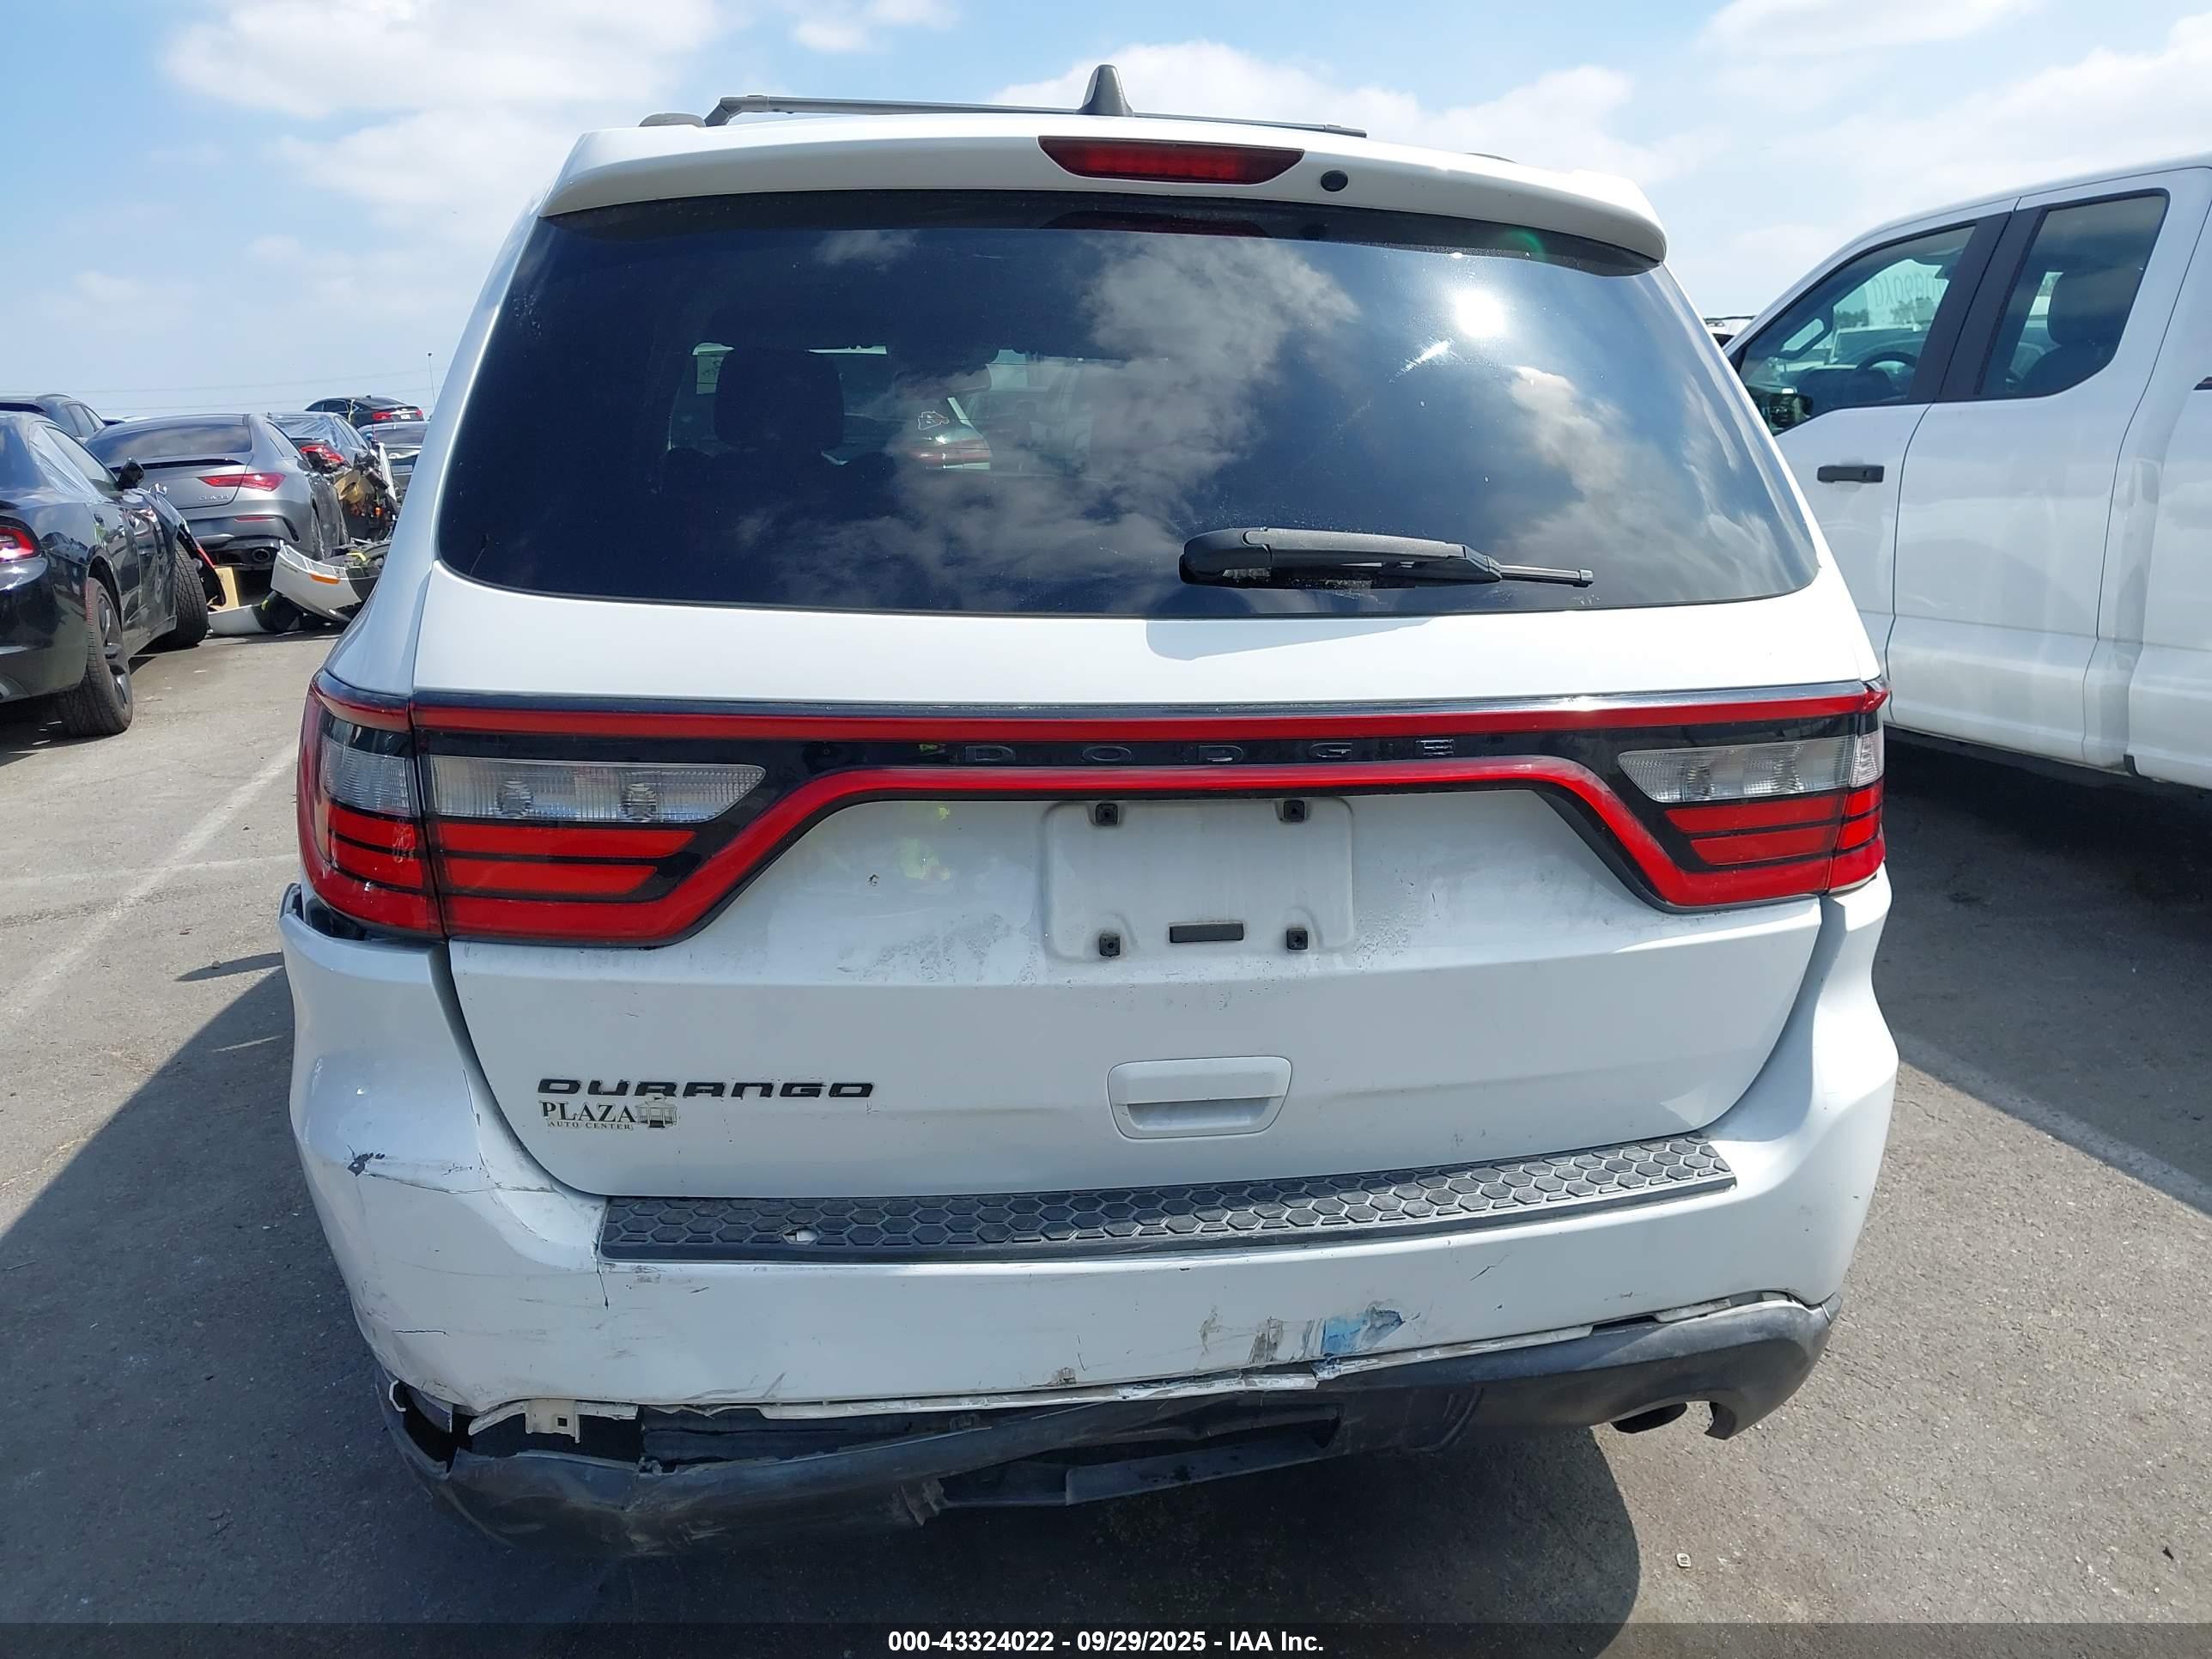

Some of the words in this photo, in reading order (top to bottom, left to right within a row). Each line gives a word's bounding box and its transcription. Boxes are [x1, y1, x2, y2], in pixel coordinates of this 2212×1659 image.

[964, 738, 1455, 762] DODGE
[538, 1079, 873, 1098] DURANGO
[539, 1101, 637, 1122] PLAZA
